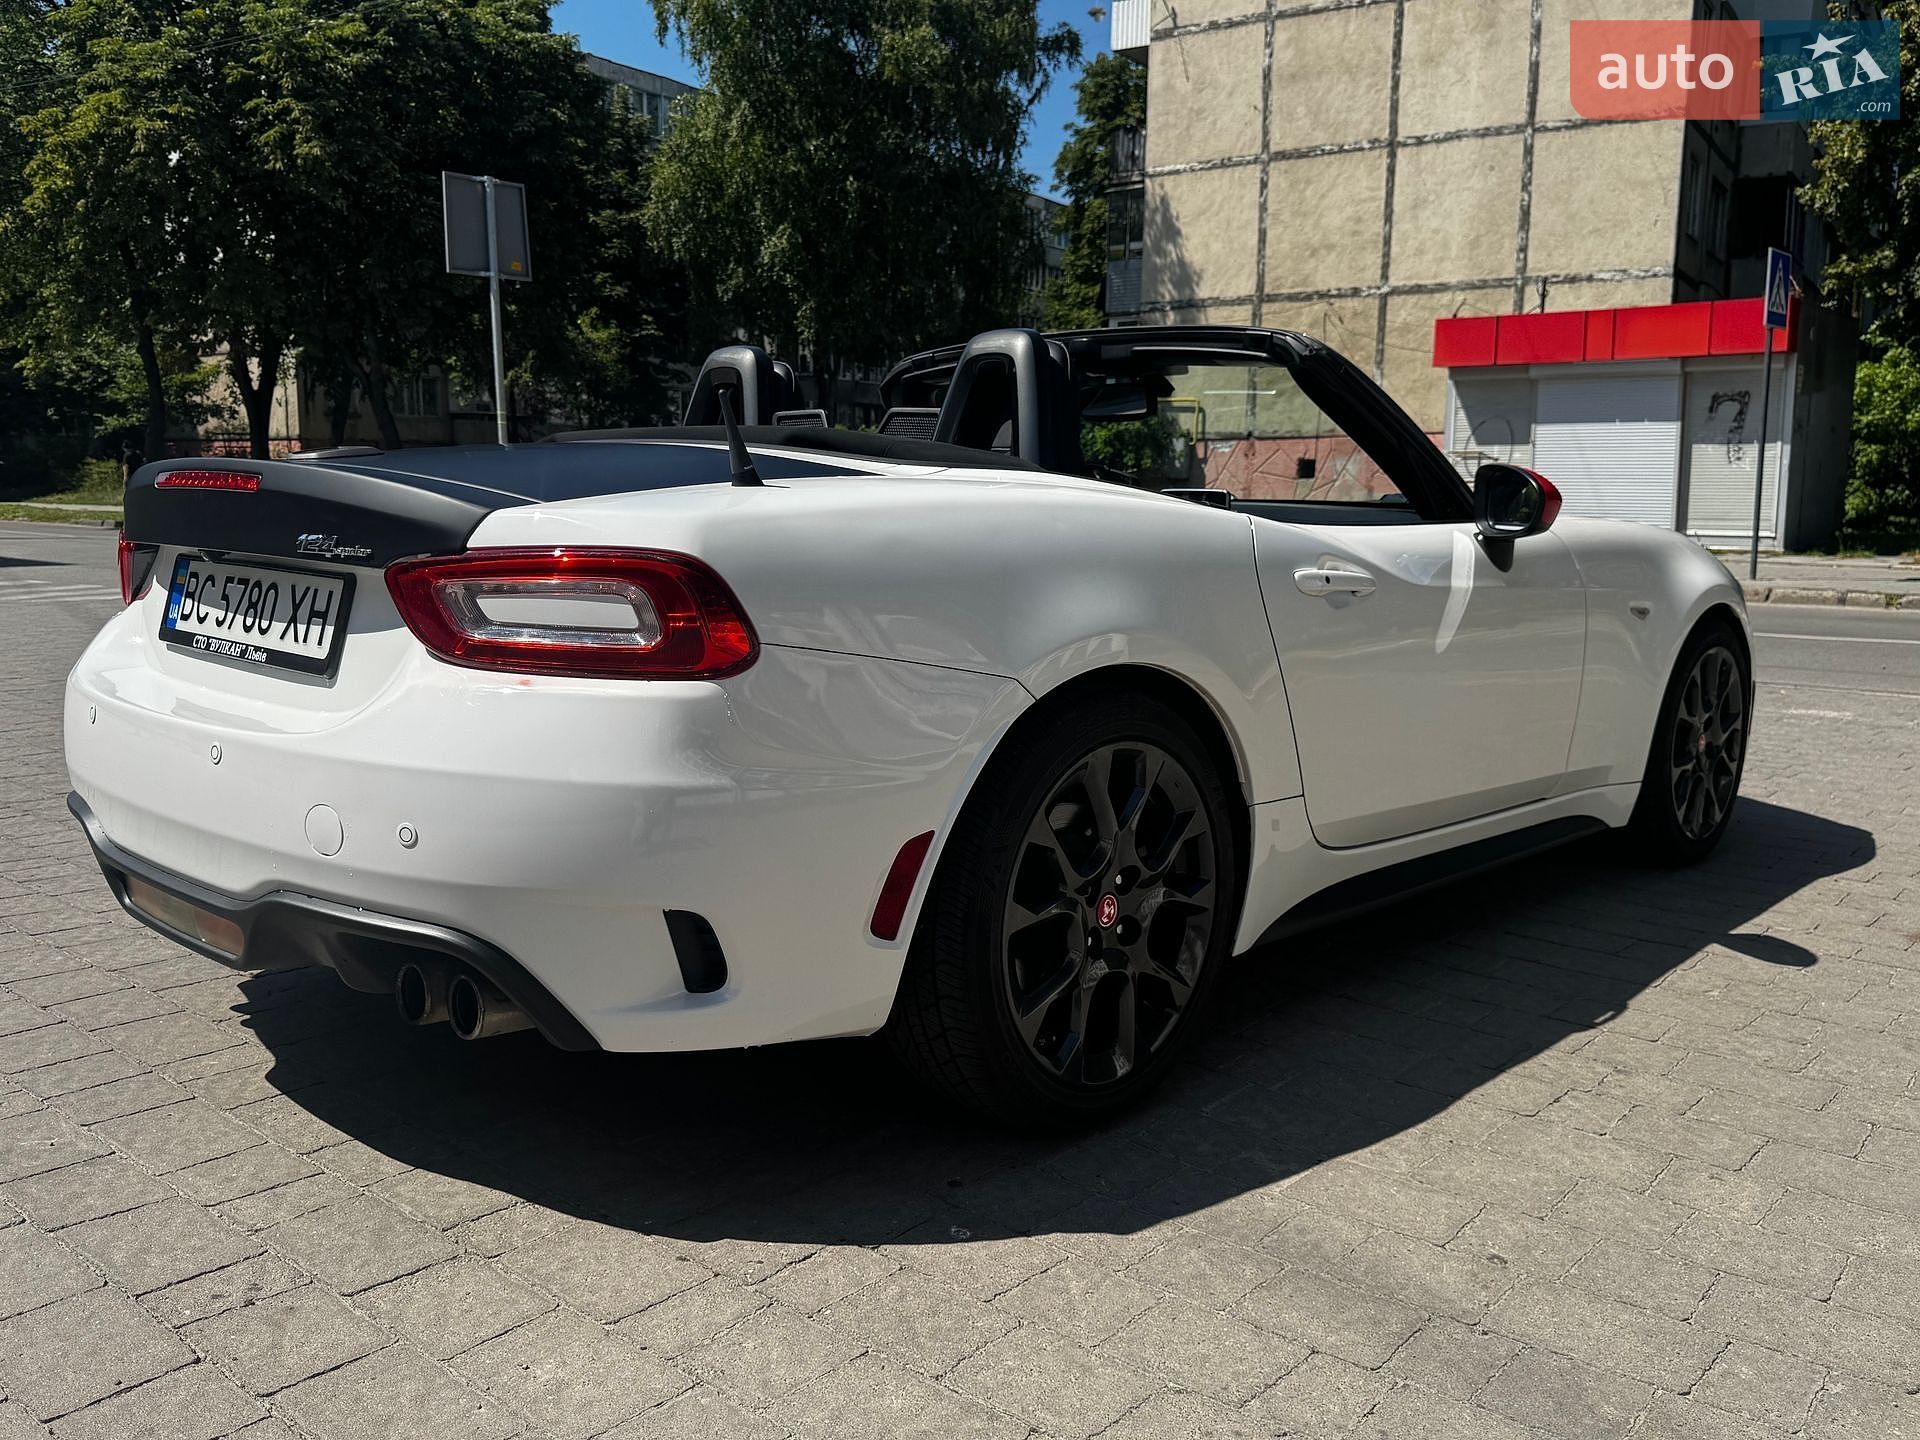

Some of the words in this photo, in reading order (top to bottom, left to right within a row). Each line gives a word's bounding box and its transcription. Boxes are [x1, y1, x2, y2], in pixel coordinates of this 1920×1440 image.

[296, 533, 338, 557] 124
[168, 603, 179, 619] UA
[179, 571, 216, 624] BC
[215, 575, 279, 636] 5780
[279, 584, 334, 646] XH
[192, 635, 208, 649] СТО
[244, 646, 267, 662] Львів
